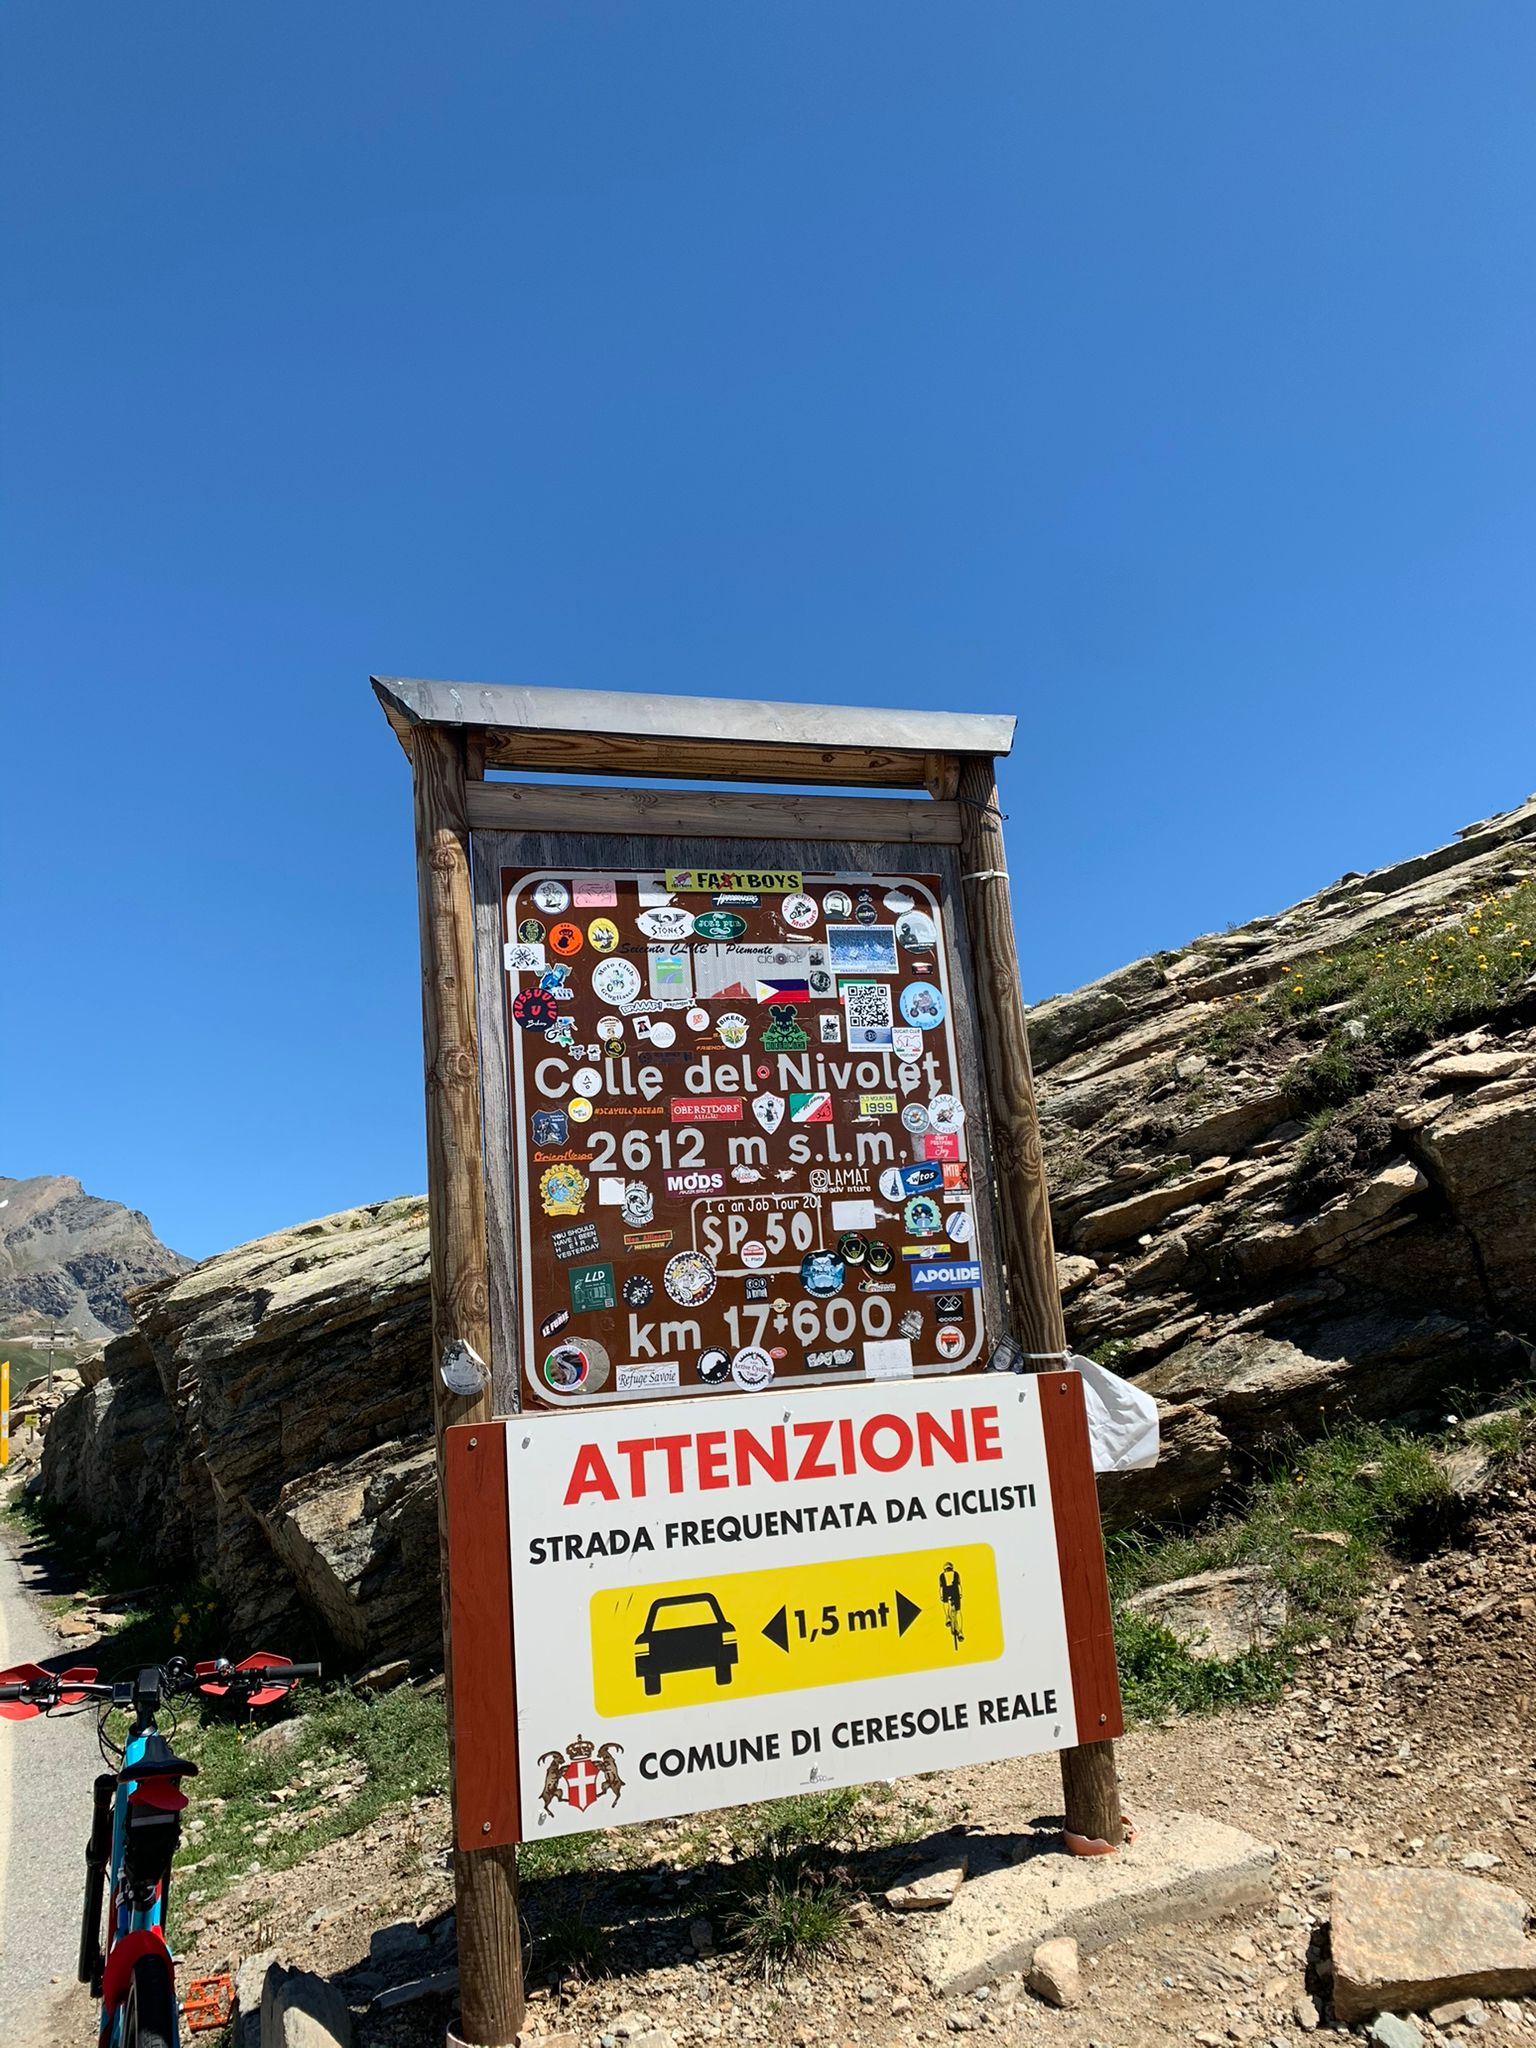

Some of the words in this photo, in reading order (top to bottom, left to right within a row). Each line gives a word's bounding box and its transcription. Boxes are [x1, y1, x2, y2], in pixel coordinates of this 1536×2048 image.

[726, 942, 774, 956] Piemonte
[718, 1014, 745, 1026] BIKERS
[535, 1056, 664, 1100] Clle
[685, 1053, 758, 1095] del
[777, 1051, 942, 1097] Nivolet
[674, 1103, 740, 1116] OBERSTDORF
[866, 1102, 893, 1113] 1999
[588, 1127, 707, 1172] 2612
[729, 1135, 769, 1166] m
[789, 1123, 908, 1166] s.l.m.
[828, 1169, 871, 1187] LAMAT
[748, 1198, 769, 1212] Job
[552, 1231, 567, 1240] YOU
[567, 1224, 595, 1236] SHOULD
[553, 1236, 573, 1247] HAVE
[578, 1230, 597, 1240] BEEN
[766, 1211, 813, 1256] 50
[557, 1243, 600, 1260] YESTERDAY
[914, 1266, 981, 1284] APOLIDE
[629, 1313, 702, 1358] km
[618, 1371, 648, 1389] Refuge
[648, 1369, 677, 1383] Savoie
[563, 1405, 1003, 1506] ATTENZIONE
[529, 1525, 655, 1566] STRADA
[665, 1500, 877, 1550] FREQUENTATA
[886, 1496, 928, 1525] DA
[935, 1483, 1037, 1518] CICLISTI
[794, 1605, 841, 1643] 1,5
[848, 1601, 890, 1633] mt
[639, 1732, 782, 1781] COMUNE
[791, 1726, 821, 1758] DI
[832, 1702, 968, 1749] CERESOLE
[978, 1688, 1058, 1727] REALE
